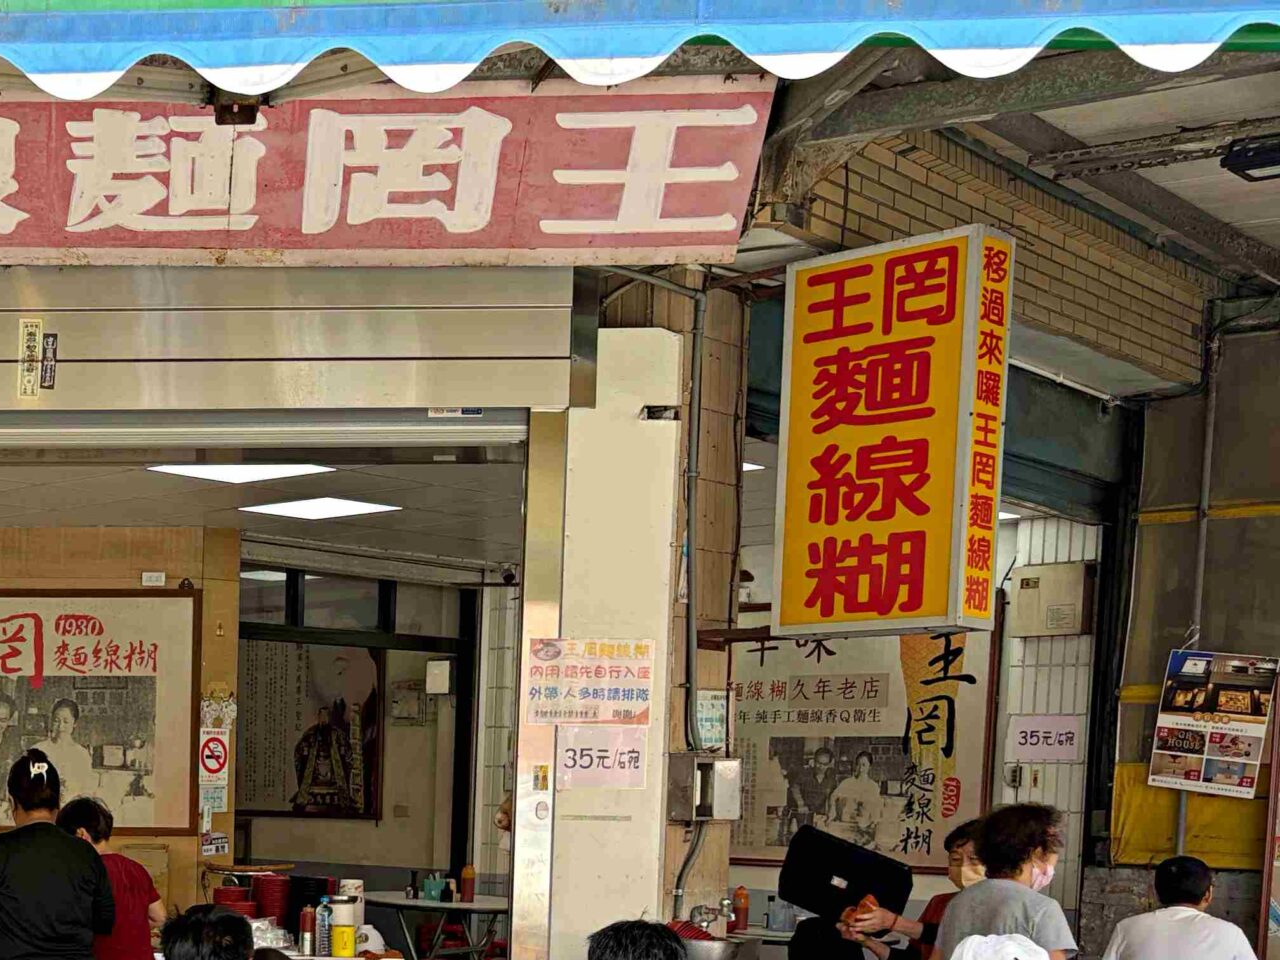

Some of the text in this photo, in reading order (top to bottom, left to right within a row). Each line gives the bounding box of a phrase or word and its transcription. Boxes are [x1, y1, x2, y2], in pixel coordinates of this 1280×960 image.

[53, 639, 159, 675] 麵線糊
[1018, 729, 1075, 746] 35元/碗
[564, 748, 640, 769] 35元/碗
